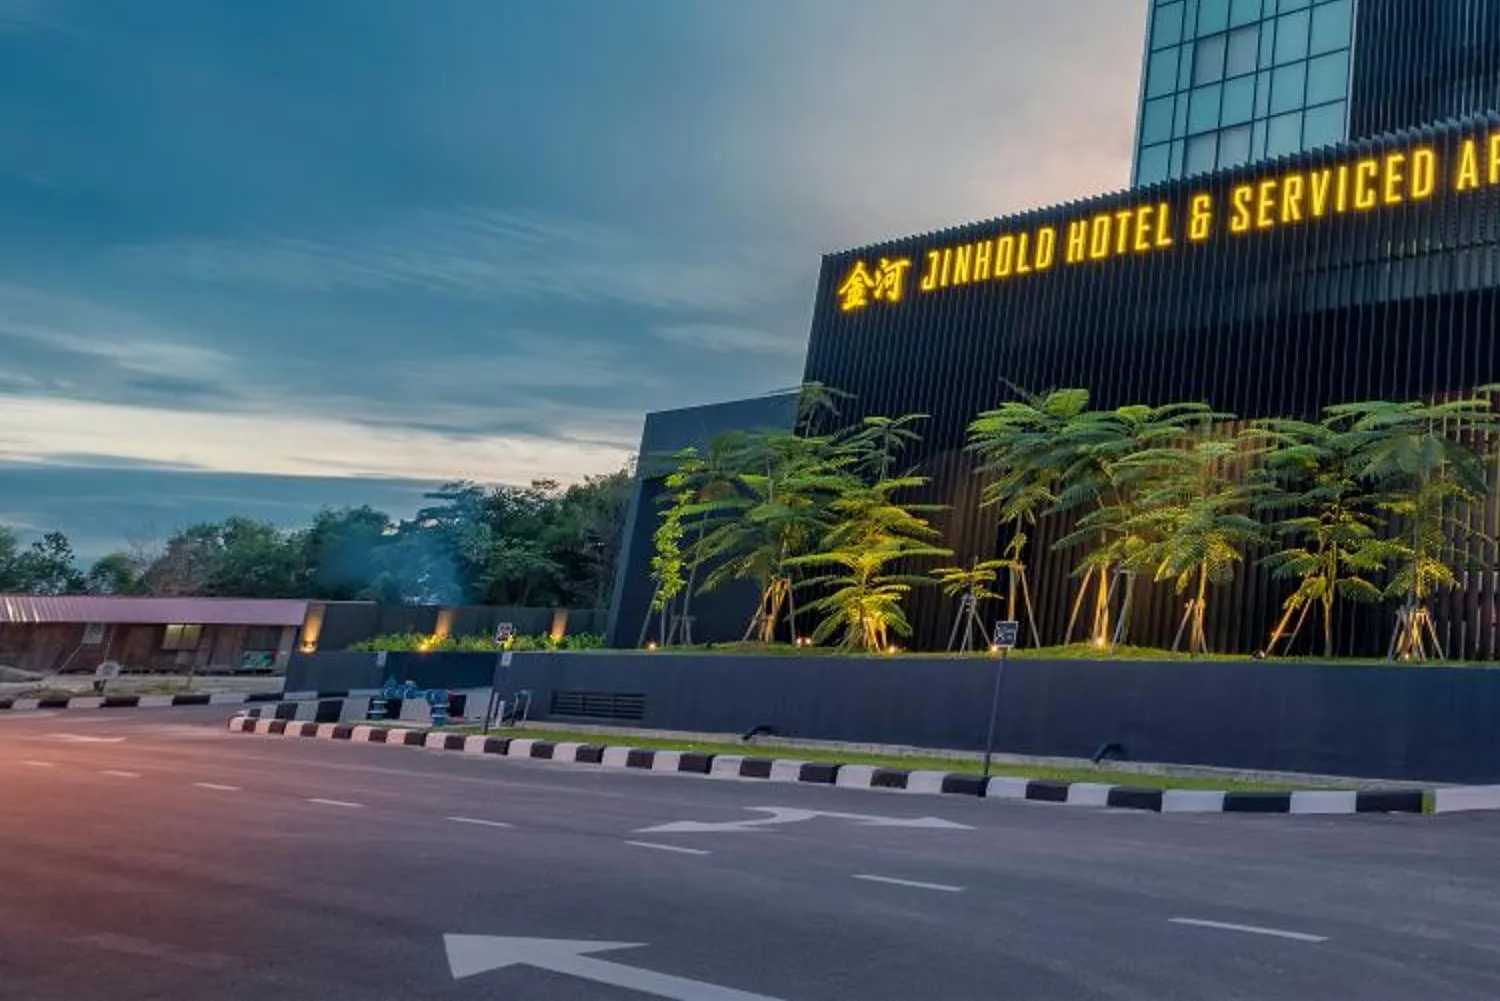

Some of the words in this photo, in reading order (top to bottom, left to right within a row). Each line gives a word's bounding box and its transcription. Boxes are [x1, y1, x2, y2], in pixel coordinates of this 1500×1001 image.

[920, 227, 1056, 291] JINHOLD
[1066, 202, 1172, 264] HOTEL
[1189, 194, 1212, 241] &
[1230, 147, 1436, 233] SERVICED
[838, 257, 911, 311] 金河
